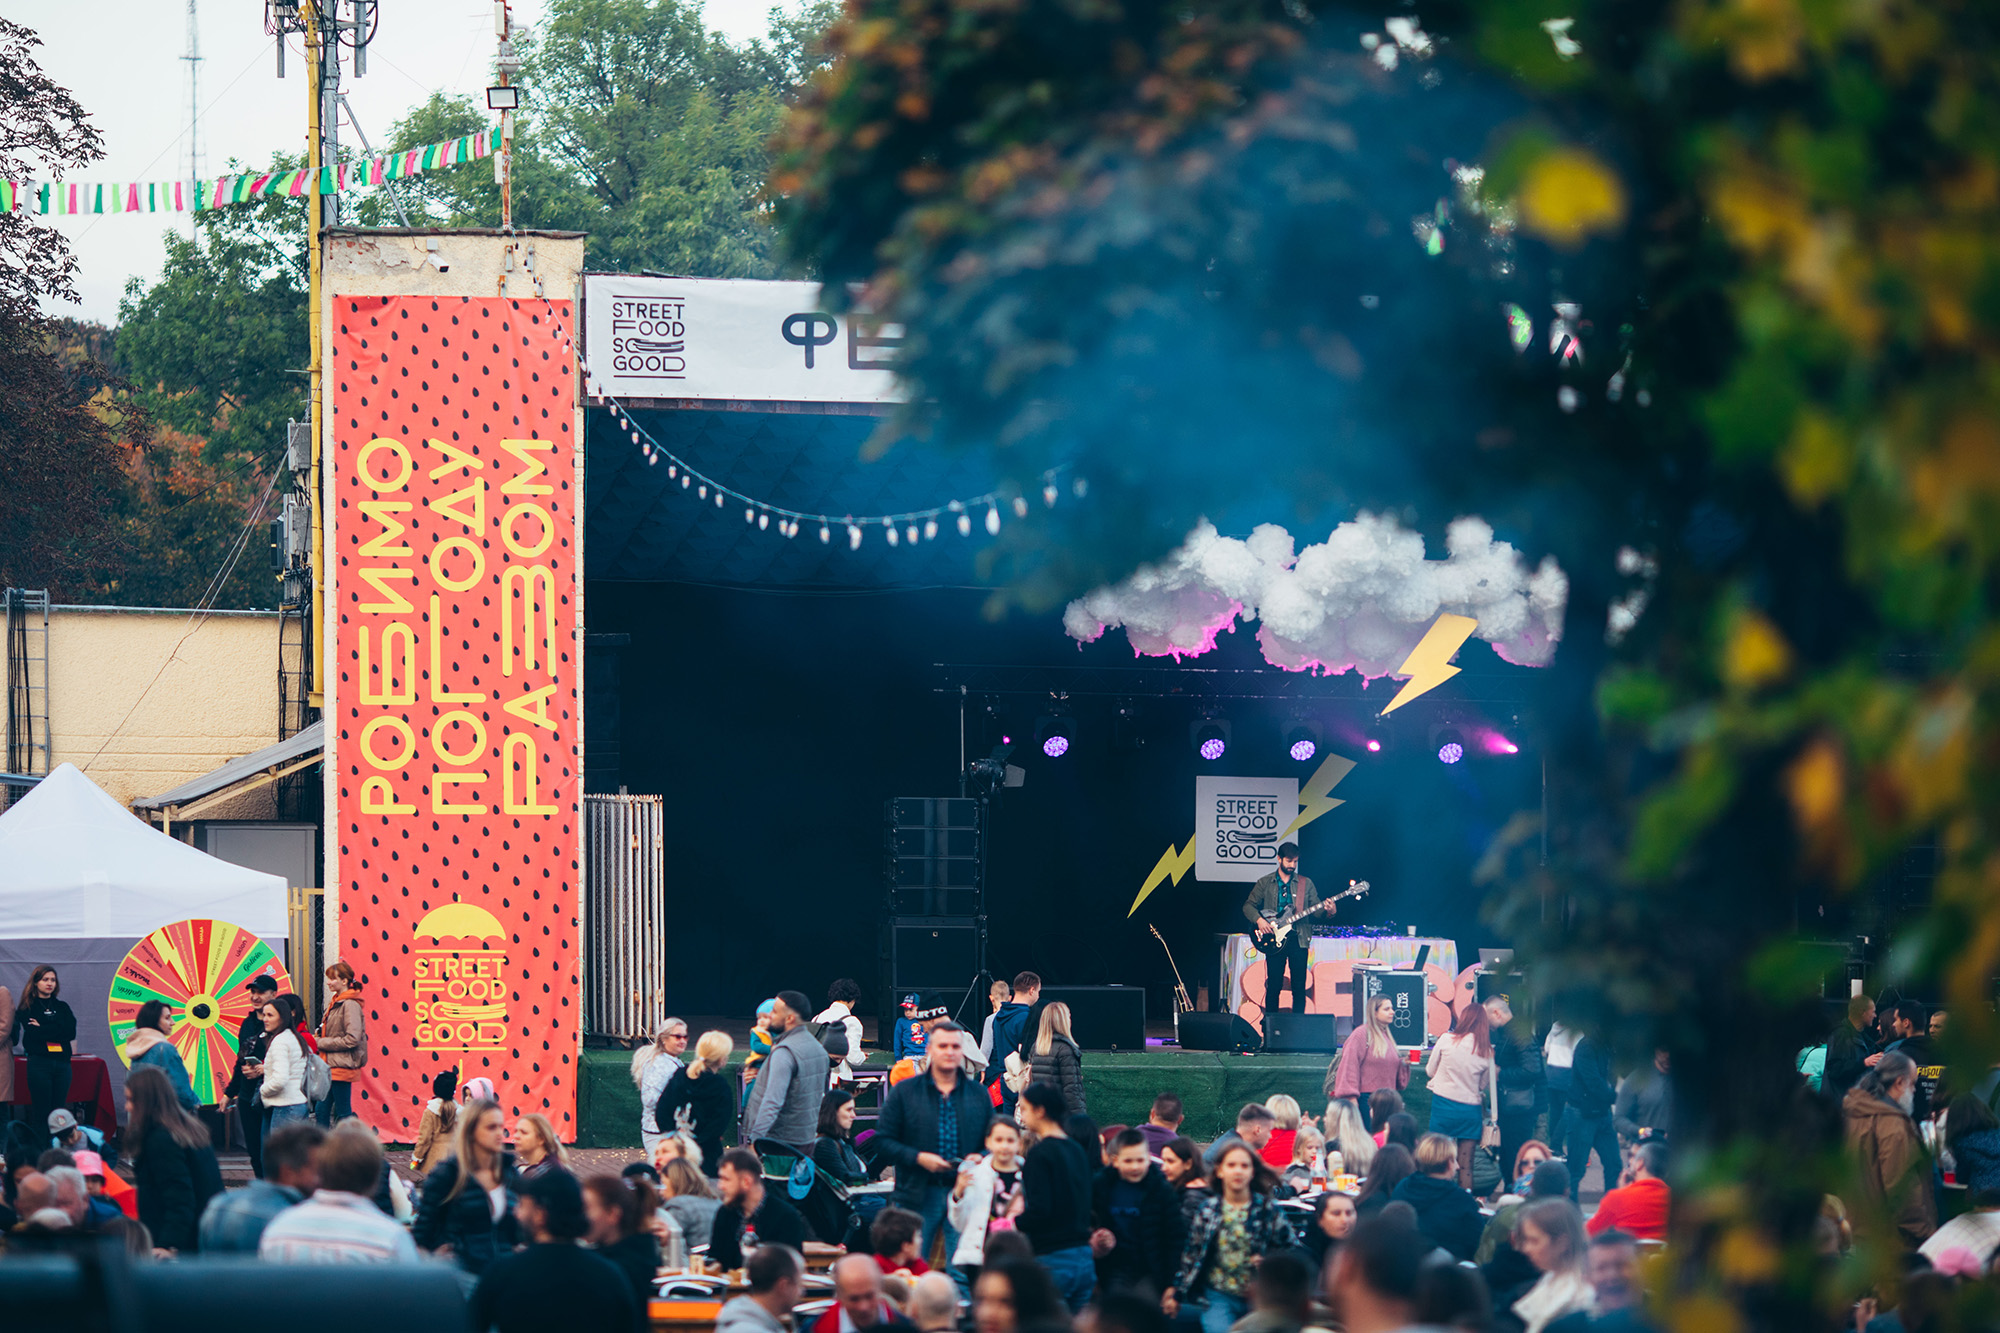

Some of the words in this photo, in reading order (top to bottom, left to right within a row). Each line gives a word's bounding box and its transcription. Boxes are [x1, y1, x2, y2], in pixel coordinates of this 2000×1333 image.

[612, 302, 685, 319] STREET
[612, 320, 685, 337] FOOD
[613, 355, 685, 372] GOOD
[356, 437, 417, 815] РОБИМО
[428, 438, 488, 815] ПОГОДУ
[499, 439, 559, 816] РАЗОМ
[1216, 800, 1278, 814] STREET
[1216, 815, 1278, 829] FOOD
[1216, 844, 1278, 859] GOOD
[414, 957, 507, 978] STREET
[414, 979, 507, 1000] FOOD
[915, 1006, 948, 1019] URTO
[415, 1022, 508, 1043] GOOD
